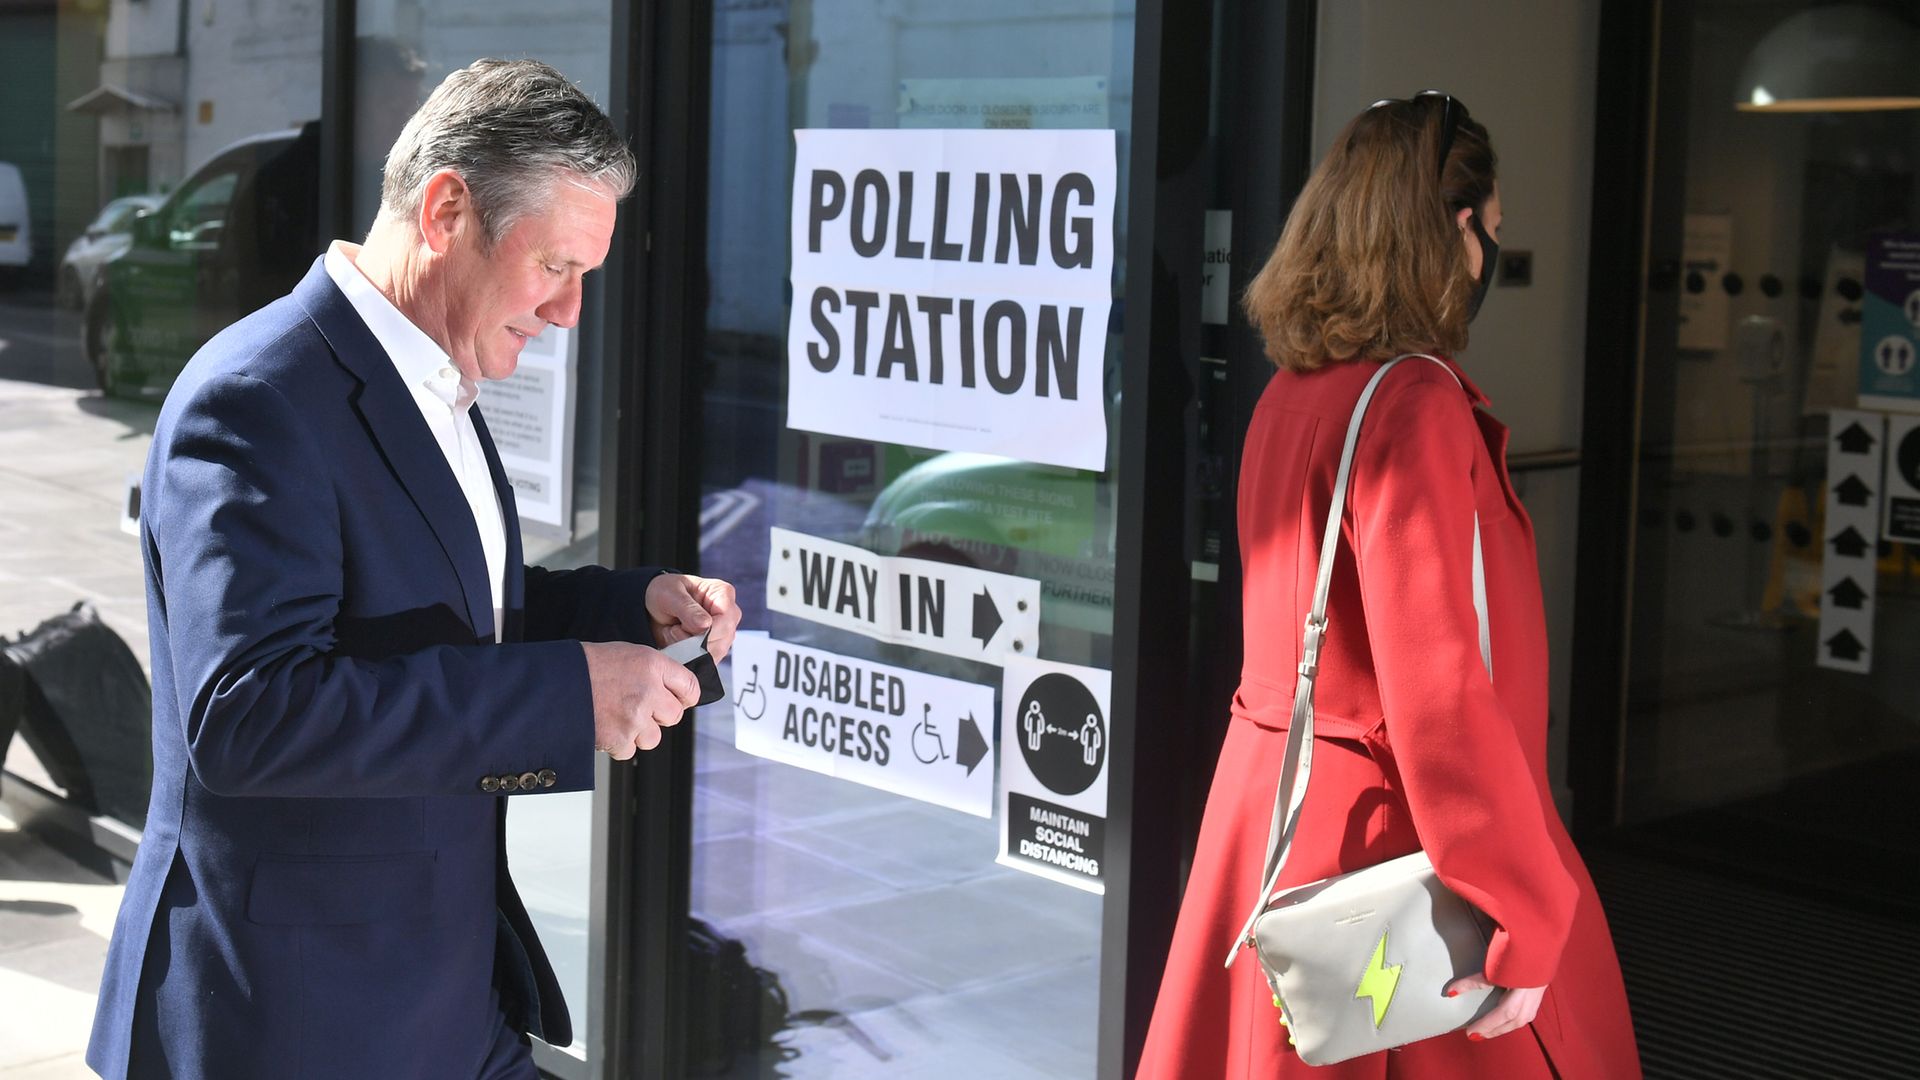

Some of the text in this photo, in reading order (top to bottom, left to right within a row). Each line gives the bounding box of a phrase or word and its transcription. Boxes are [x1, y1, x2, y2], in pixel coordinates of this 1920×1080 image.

[938, 104, 968, 115] DOOR
[1083, 104, 1101, 115] ARE
[807, 168, 1096, 270] POLLING
[806, 286, 1085, 401] STATION
[799, 548, 945, 638] WAY IN
[1043, 579, 1112, 607] FURTHER
[774, 650, 906, 717] DISABLED
[783, 703, 891, 766] ACCESS
[1029, 806, 1090, 838] MAINTAIN
[1035, 825, 1084, 853] SOCIAL
[1020, 838, 1099, 876] DISTANCING
